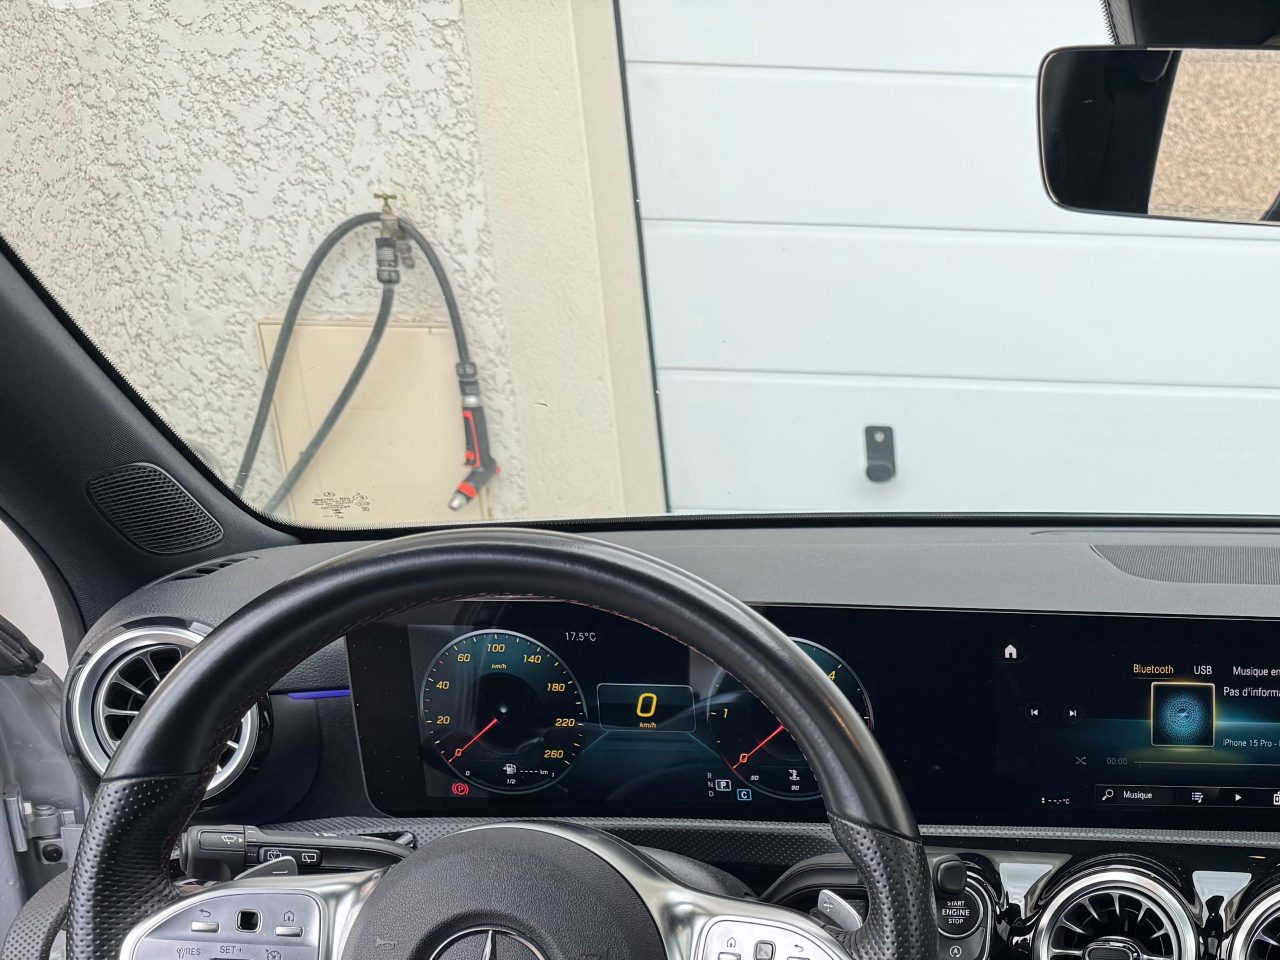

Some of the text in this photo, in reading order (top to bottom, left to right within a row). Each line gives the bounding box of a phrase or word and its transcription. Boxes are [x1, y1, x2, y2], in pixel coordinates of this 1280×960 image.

[487, 644, 506, 653] 100
[457, 653, 471, 662] 60
[523, 655, 542, 664] 140
[1133, 663, 1174, 674] Bluetooth
[1193, 665, 1213, 675] USB
[1232, 666, 1269, 678] Musique
[436, 681, 450, 690] 40
[547, 683, 566, 692] 180
[1223, 687, 1240, 697] Pas
[636, 692, 658, 718] 0
[723, 708, 729, 719] 1
[437, 716, 450, 725] 20
[555, 718, 576, 727] 220
[1222, 738, 1247, 748] iPhone
[1249, 739, 1258, 748] 15
[1260, 739, 1273, 748] Pro
[544, 750, 564, 758] 260
[1106, 757, 1128, 765] 00:00
[1123, 790, 1153, 800] Musique
[219, 945, 237, 954] SET
